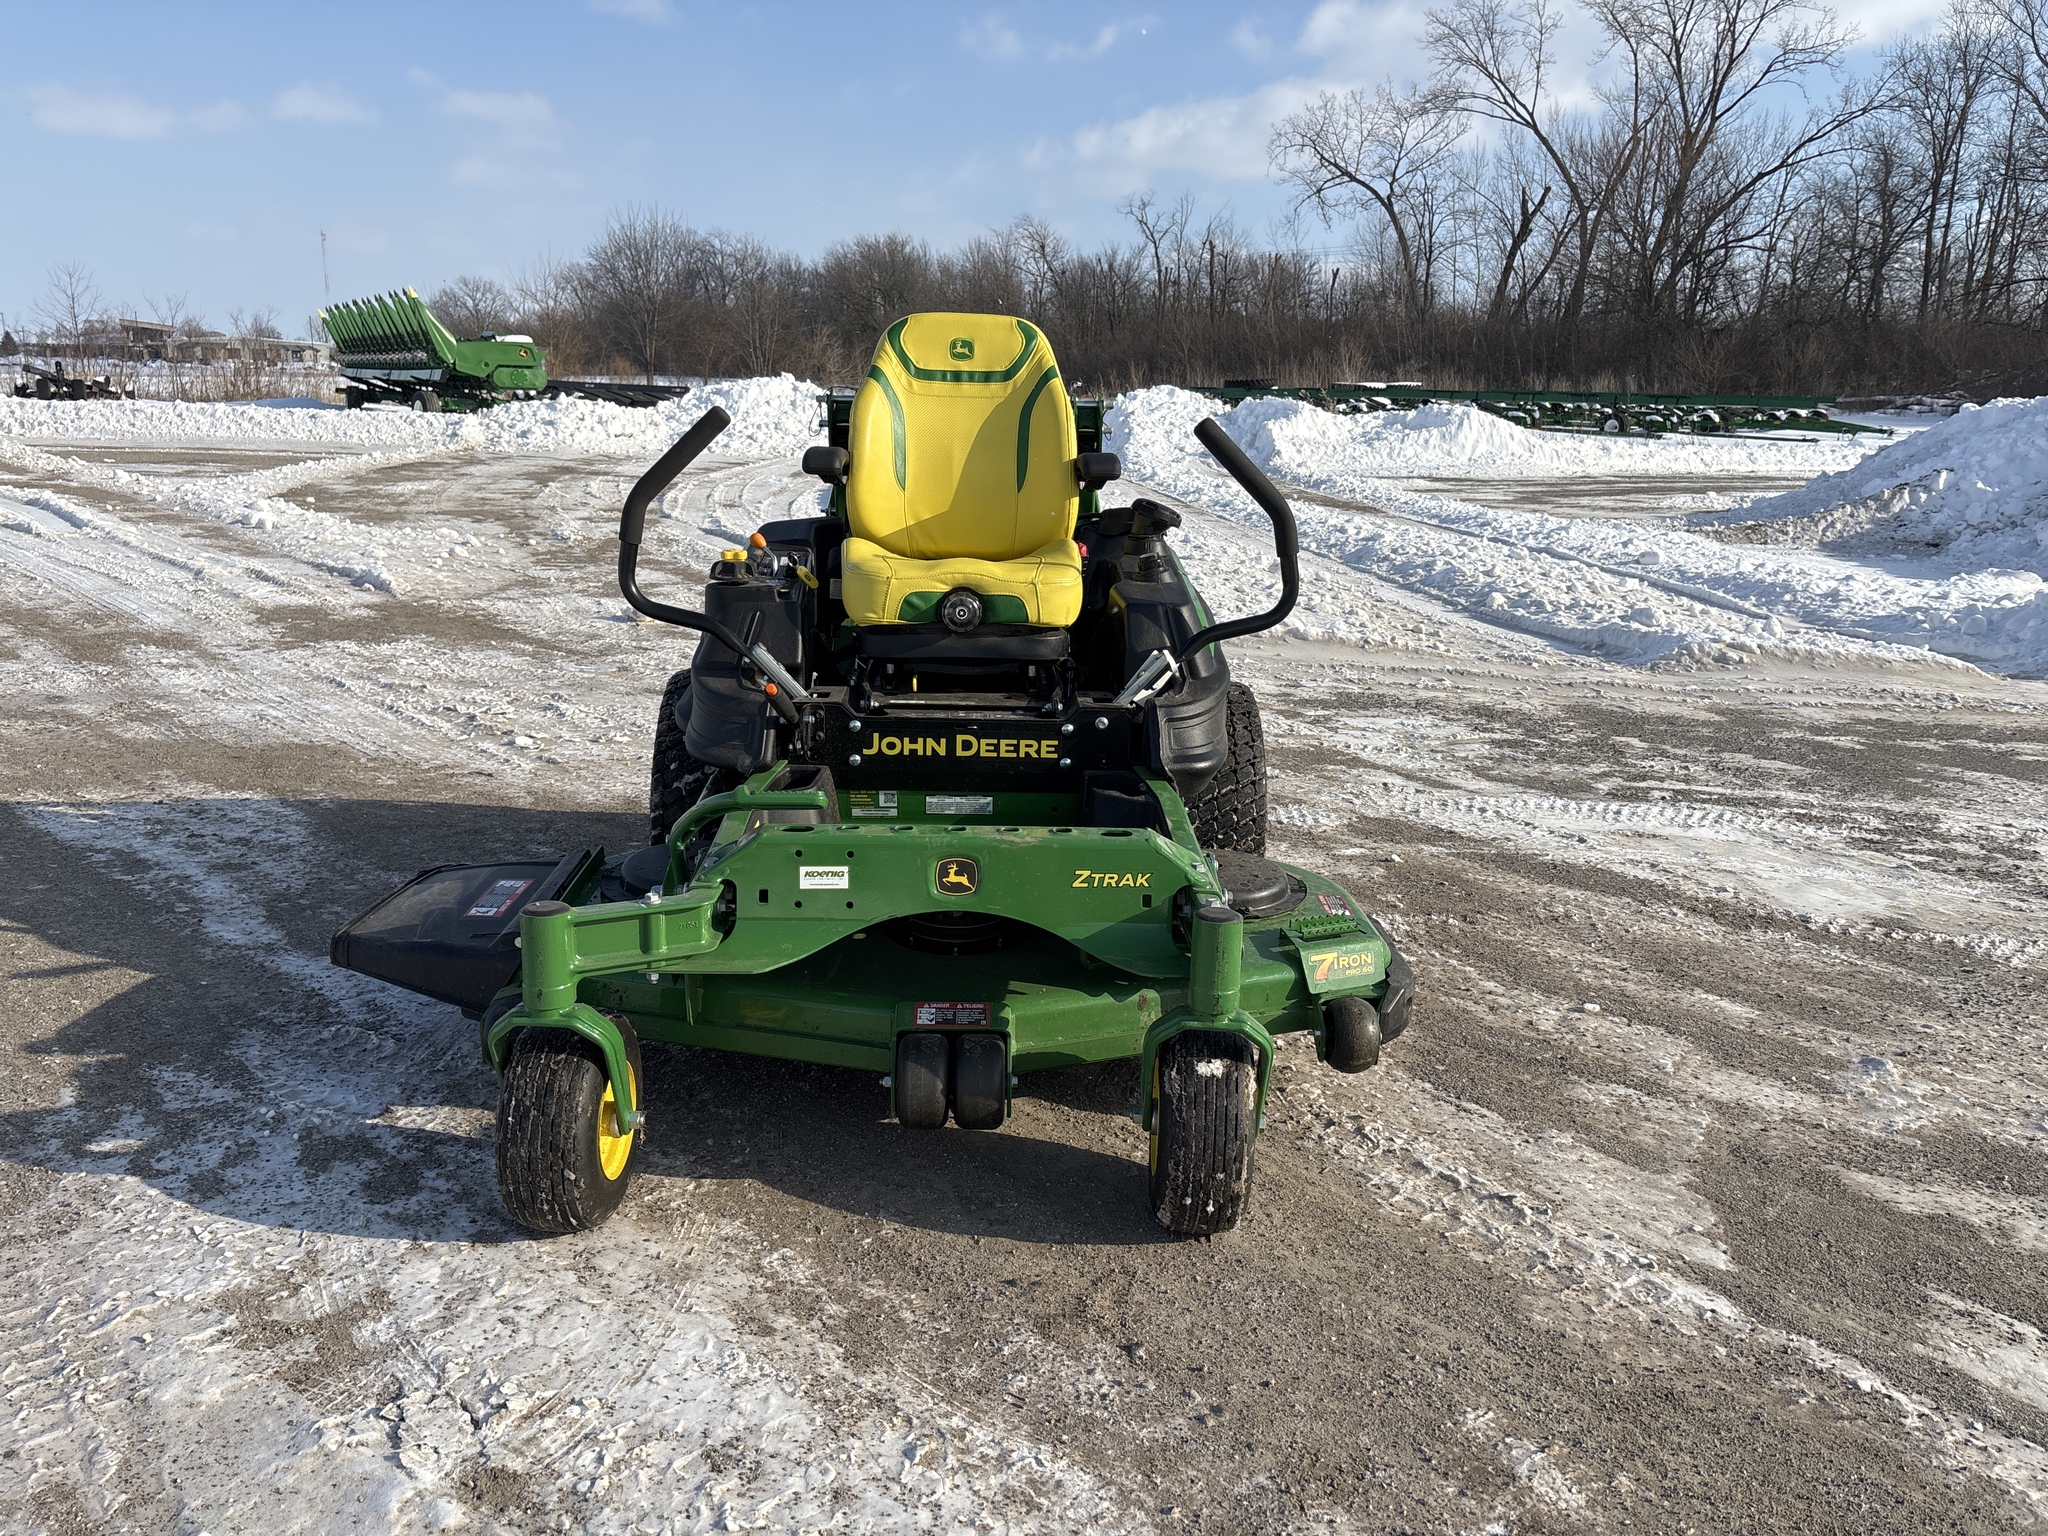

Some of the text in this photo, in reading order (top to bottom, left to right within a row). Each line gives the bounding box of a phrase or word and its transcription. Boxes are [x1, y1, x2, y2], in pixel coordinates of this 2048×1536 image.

[863, 733, 1059, 758] JOHN DEERE
[1071, 870, 1152, 888] ZTRAK
[1345, 968, 1361, 976] PRO
